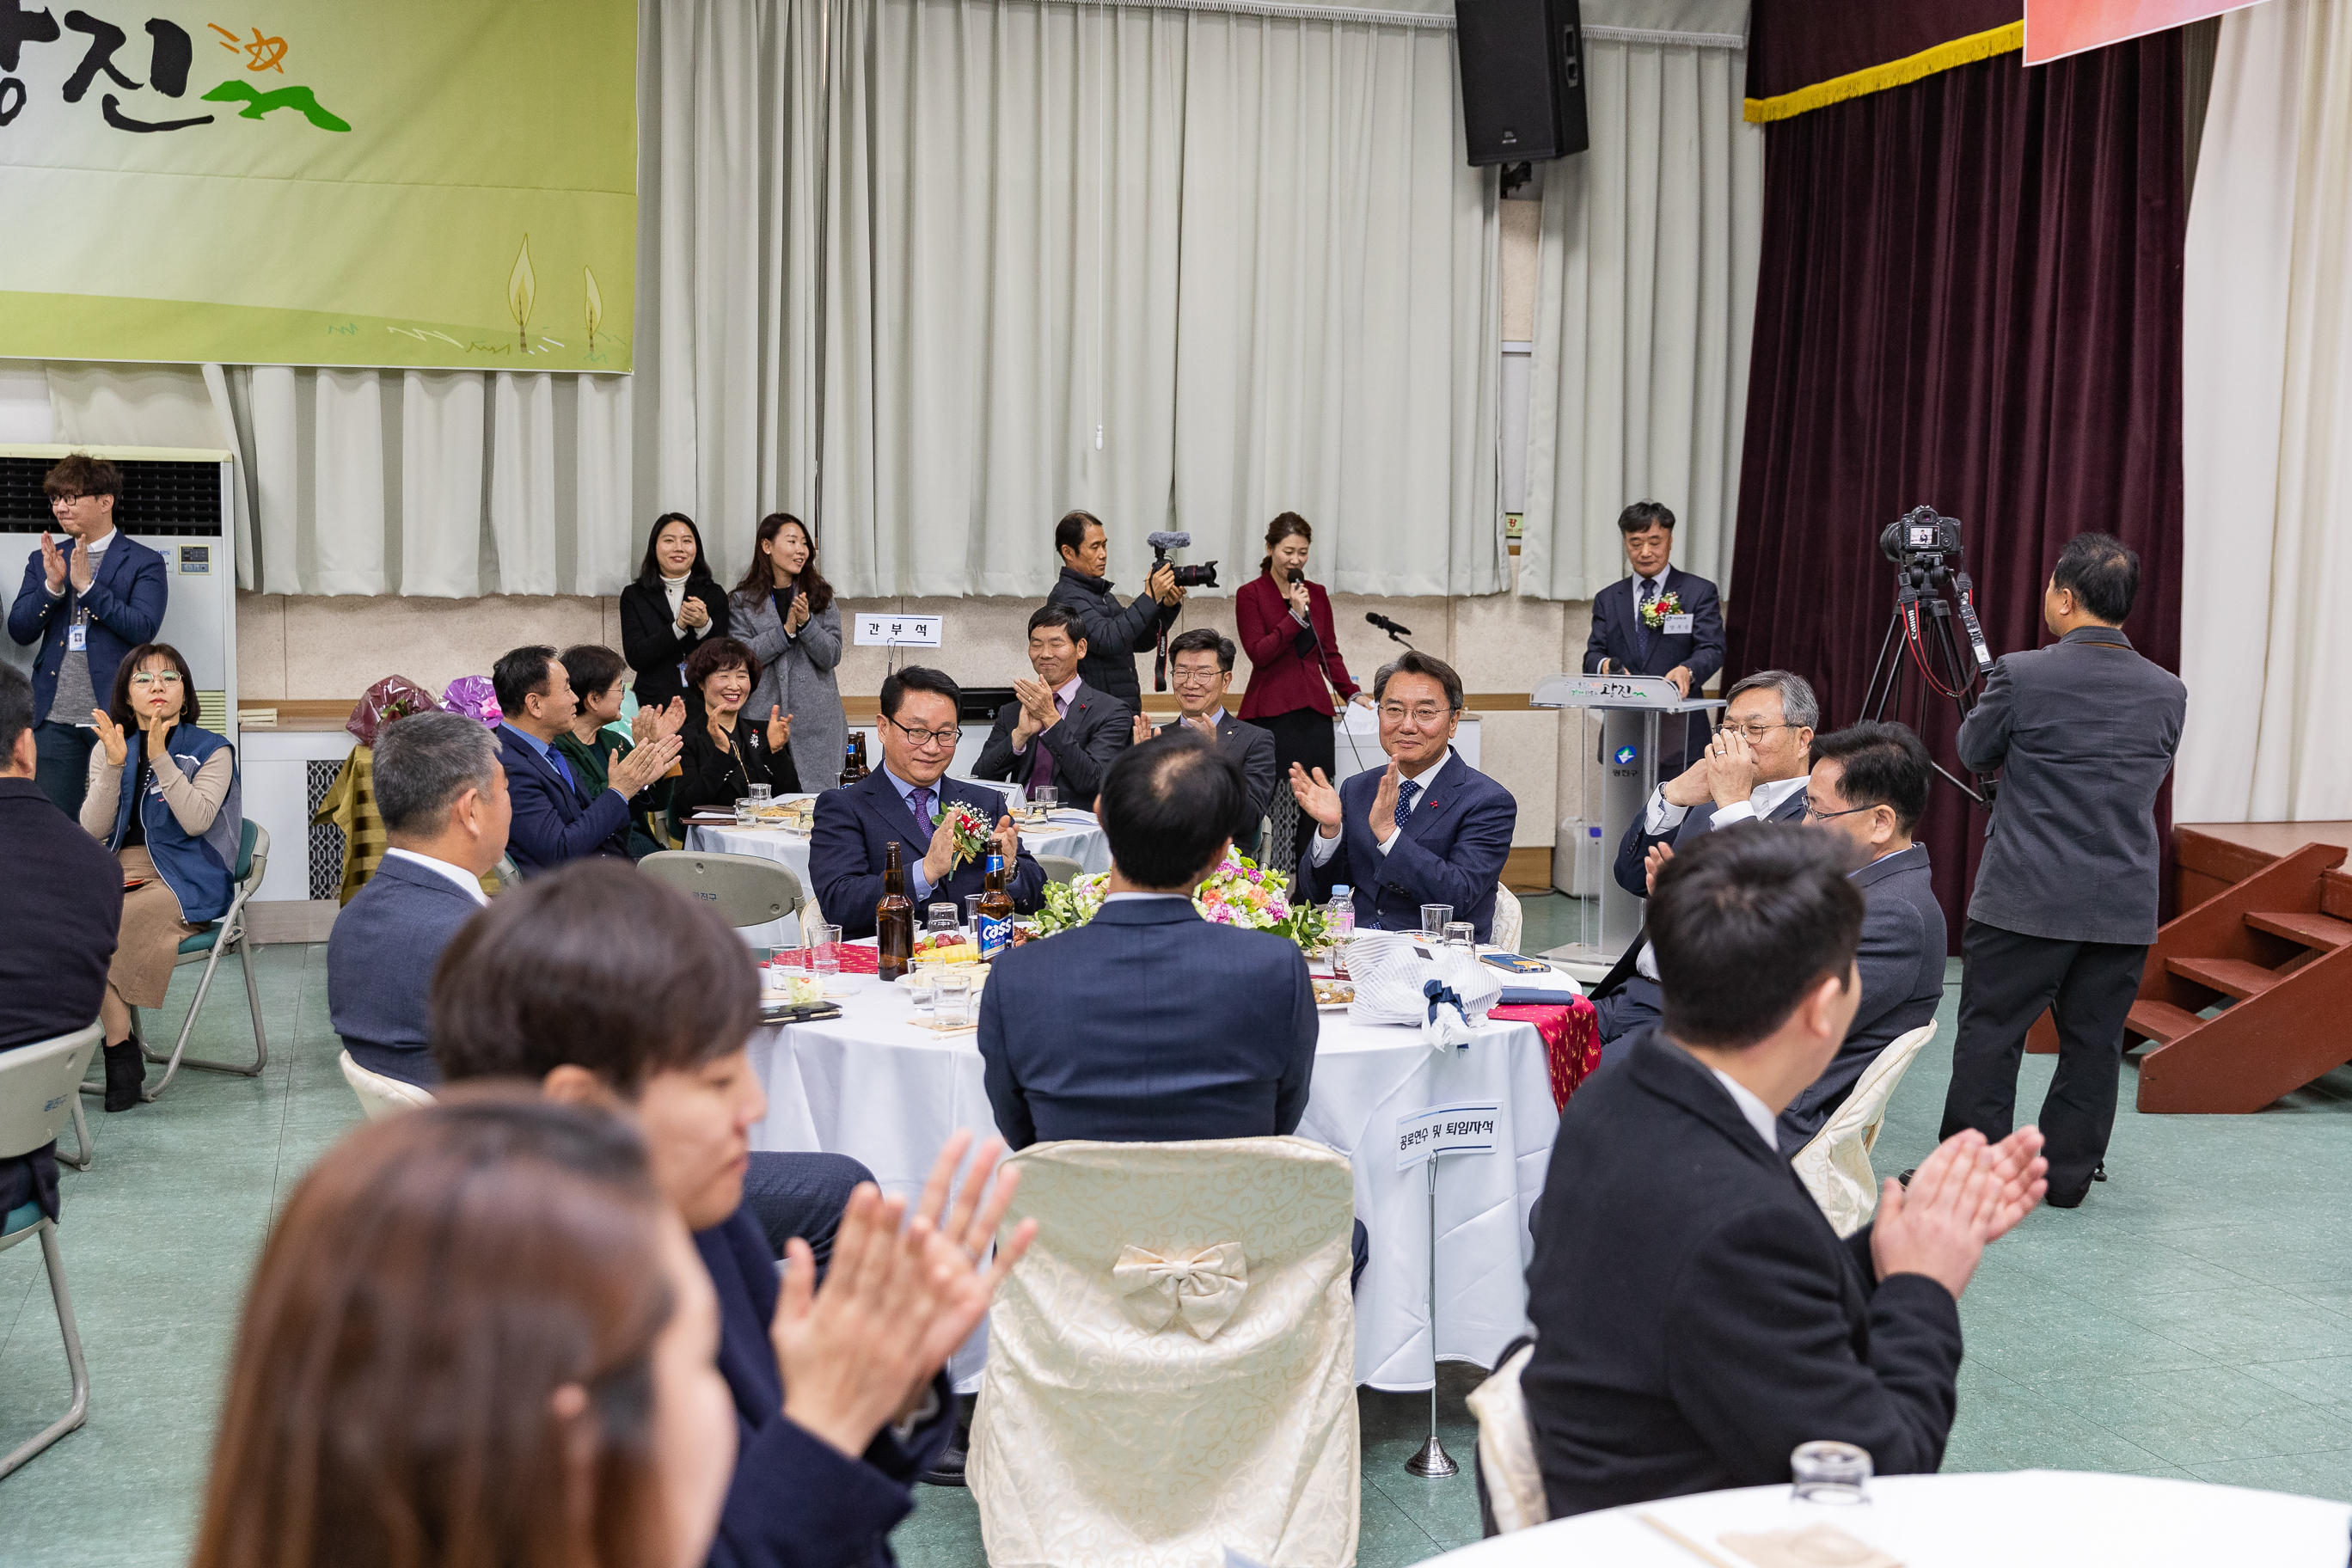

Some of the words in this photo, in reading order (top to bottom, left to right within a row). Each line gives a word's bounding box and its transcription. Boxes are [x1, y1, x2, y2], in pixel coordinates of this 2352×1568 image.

[1908, 609, 1917, 640] Canon
[1600, 682, 1633, 699] 광진
[1400, 1127, 1429, 1151] 공로연수
[1432, 1124, 1442, 1139] 및
[1446, 1120, 1494, 1136] 퇴임자석
